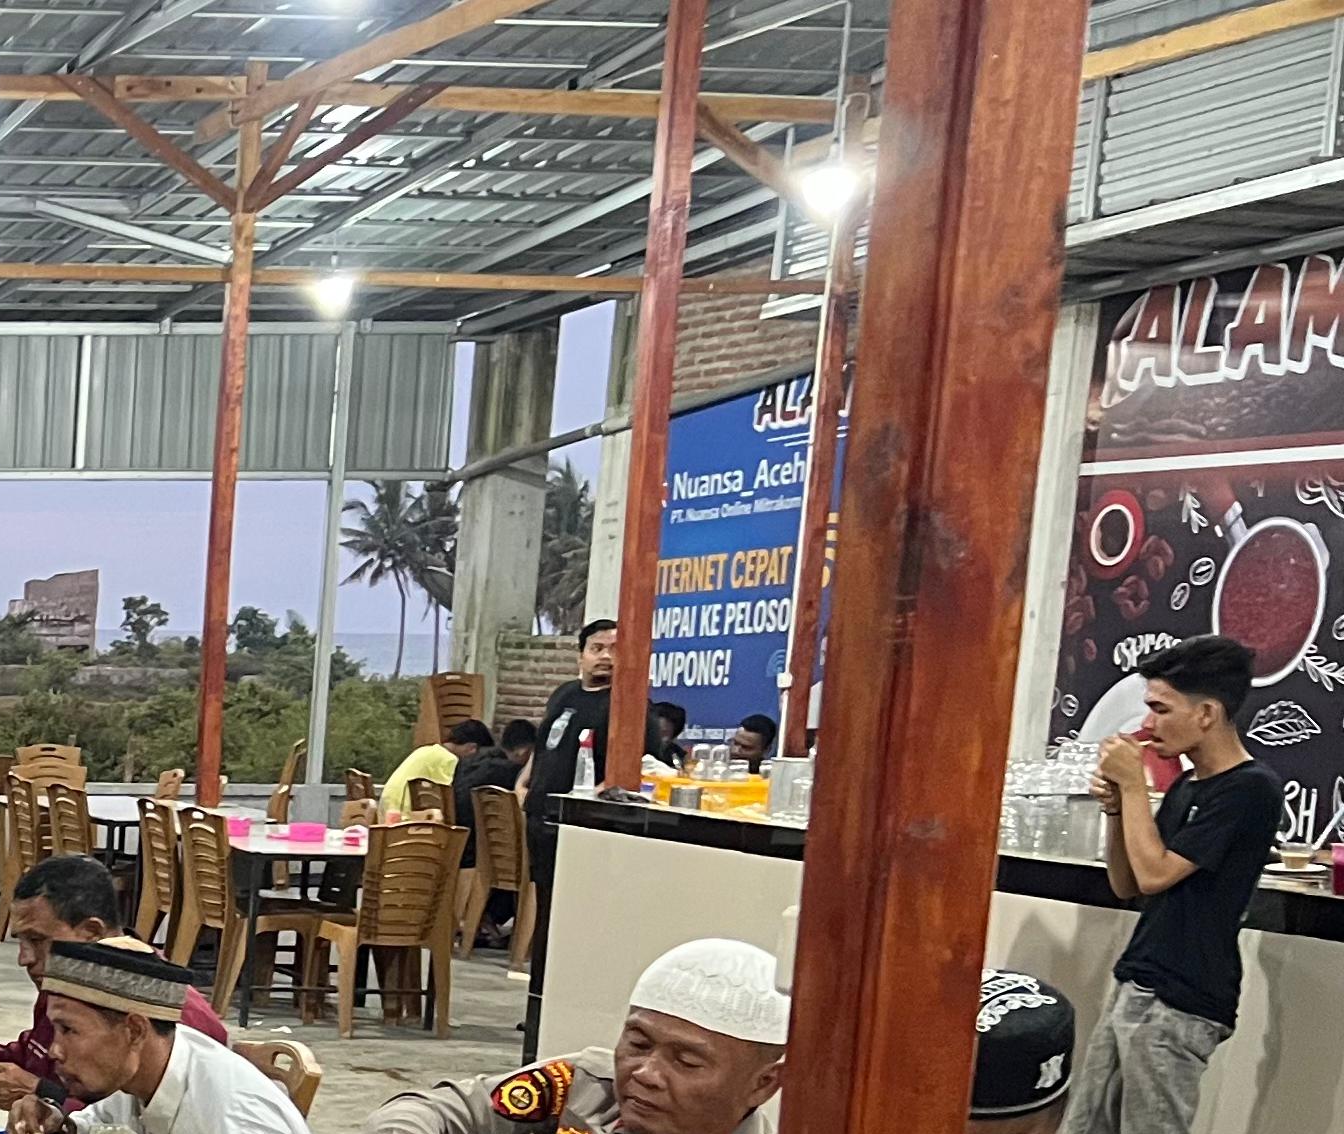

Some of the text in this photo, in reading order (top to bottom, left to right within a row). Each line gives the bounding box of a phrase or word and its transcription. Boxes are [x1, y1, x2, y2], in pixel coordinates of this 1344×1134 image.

[655, 546, 793, 595] TERNET CEPAT
[699, 603, 722, 637] KE
[724, 598, 792, 635] PELOSO
[648, 649, 732, 687] AMPONG!
